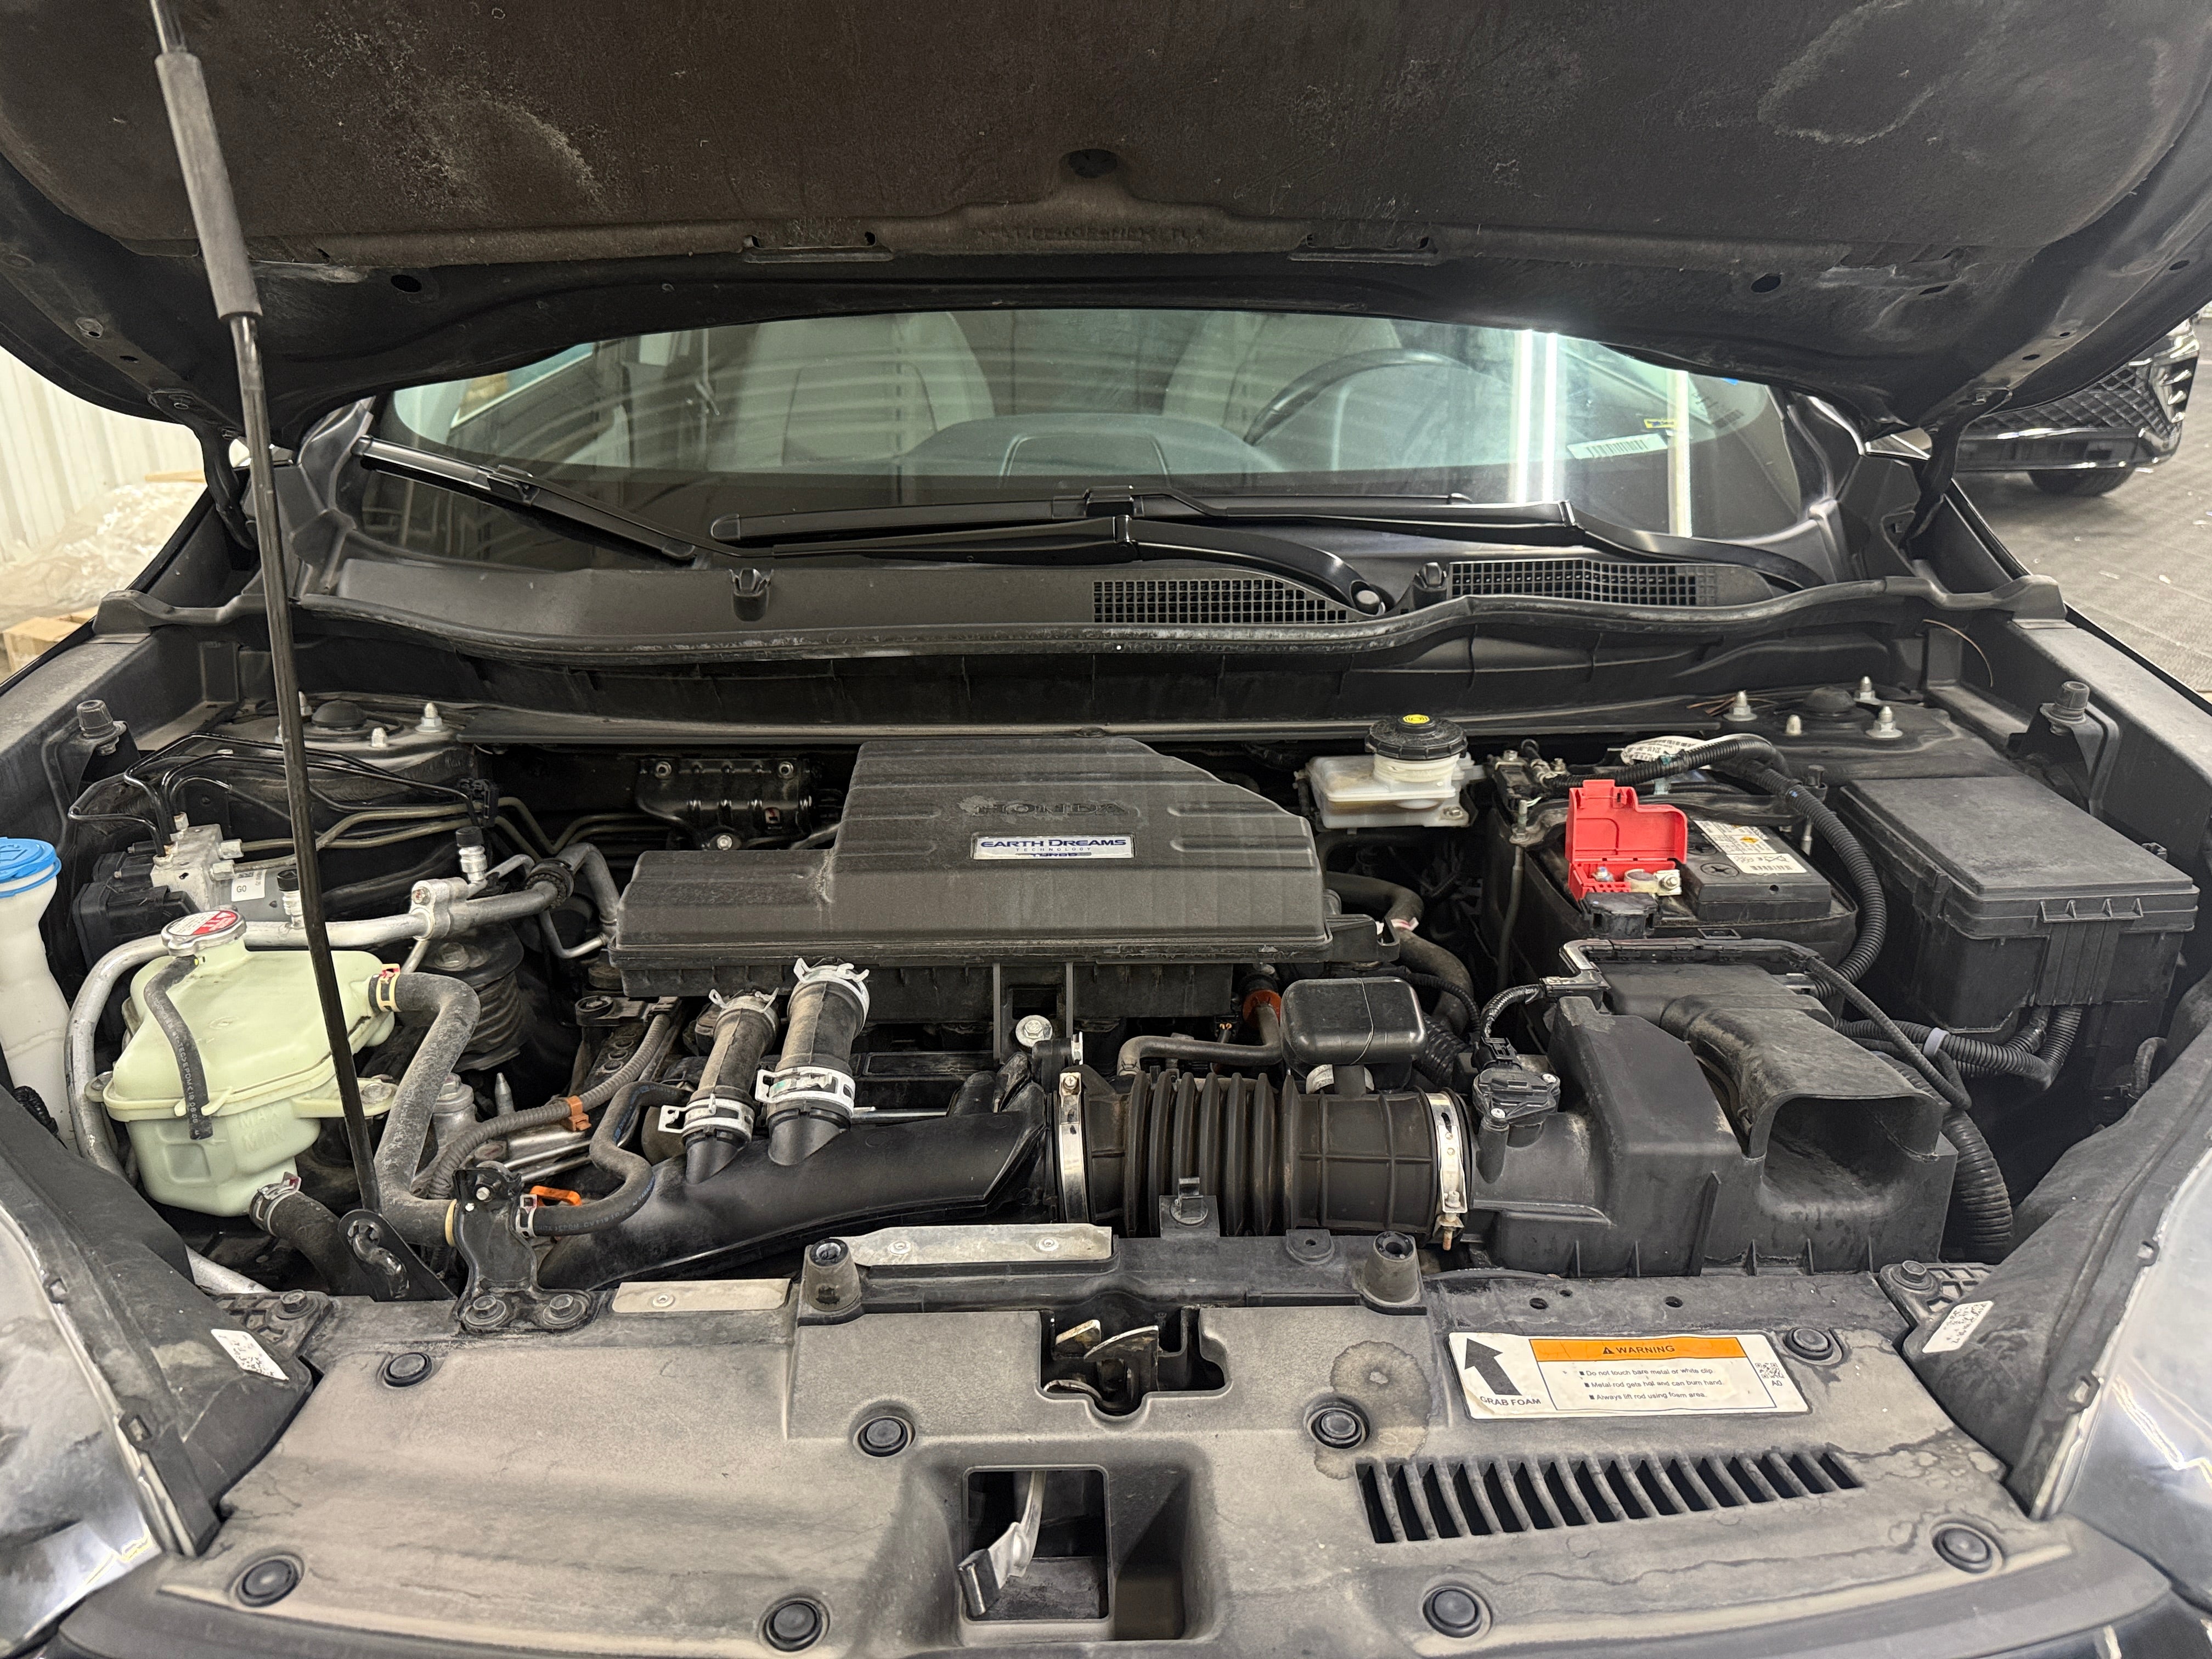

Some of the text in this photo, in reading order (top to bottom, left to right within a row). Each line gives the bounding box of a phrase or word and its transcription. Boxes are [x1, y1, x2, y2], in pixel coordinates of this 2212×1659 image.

[239, 1105, 278, 1129] MAX
[244, 1124, 285, 1153] MIN
[1616, 1345, 1675, 1354] WARNING
[1480, 1396, 1509, 1406] GRAB
